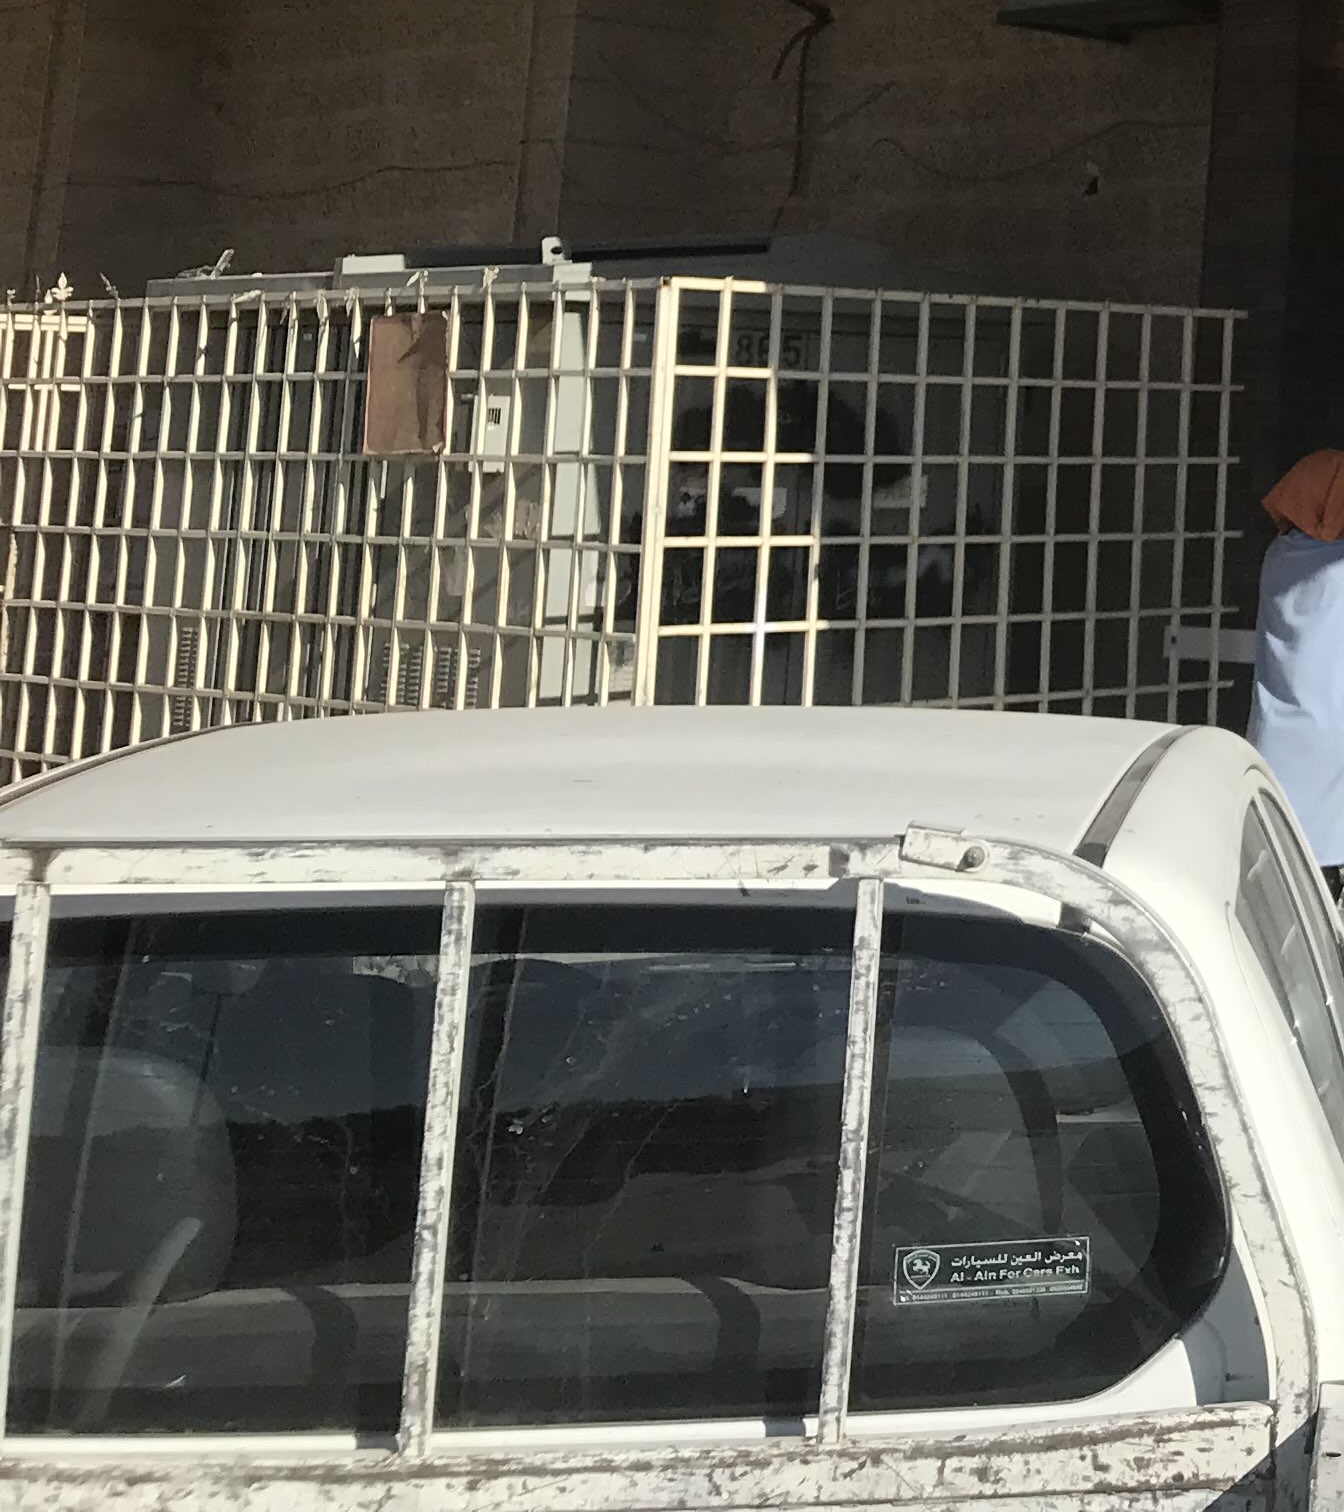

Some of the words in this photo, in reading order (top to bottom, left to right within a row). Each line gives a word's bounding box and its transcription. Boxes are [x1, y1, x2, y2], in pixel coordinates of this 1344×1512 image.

[951, 1252, 1008, 1269] للسيارات
[1010, 1251, 1042, 1266] العين
[1045, 1250, 1083, 1264] معرض
[999, 1269, 1021, 1280] For
